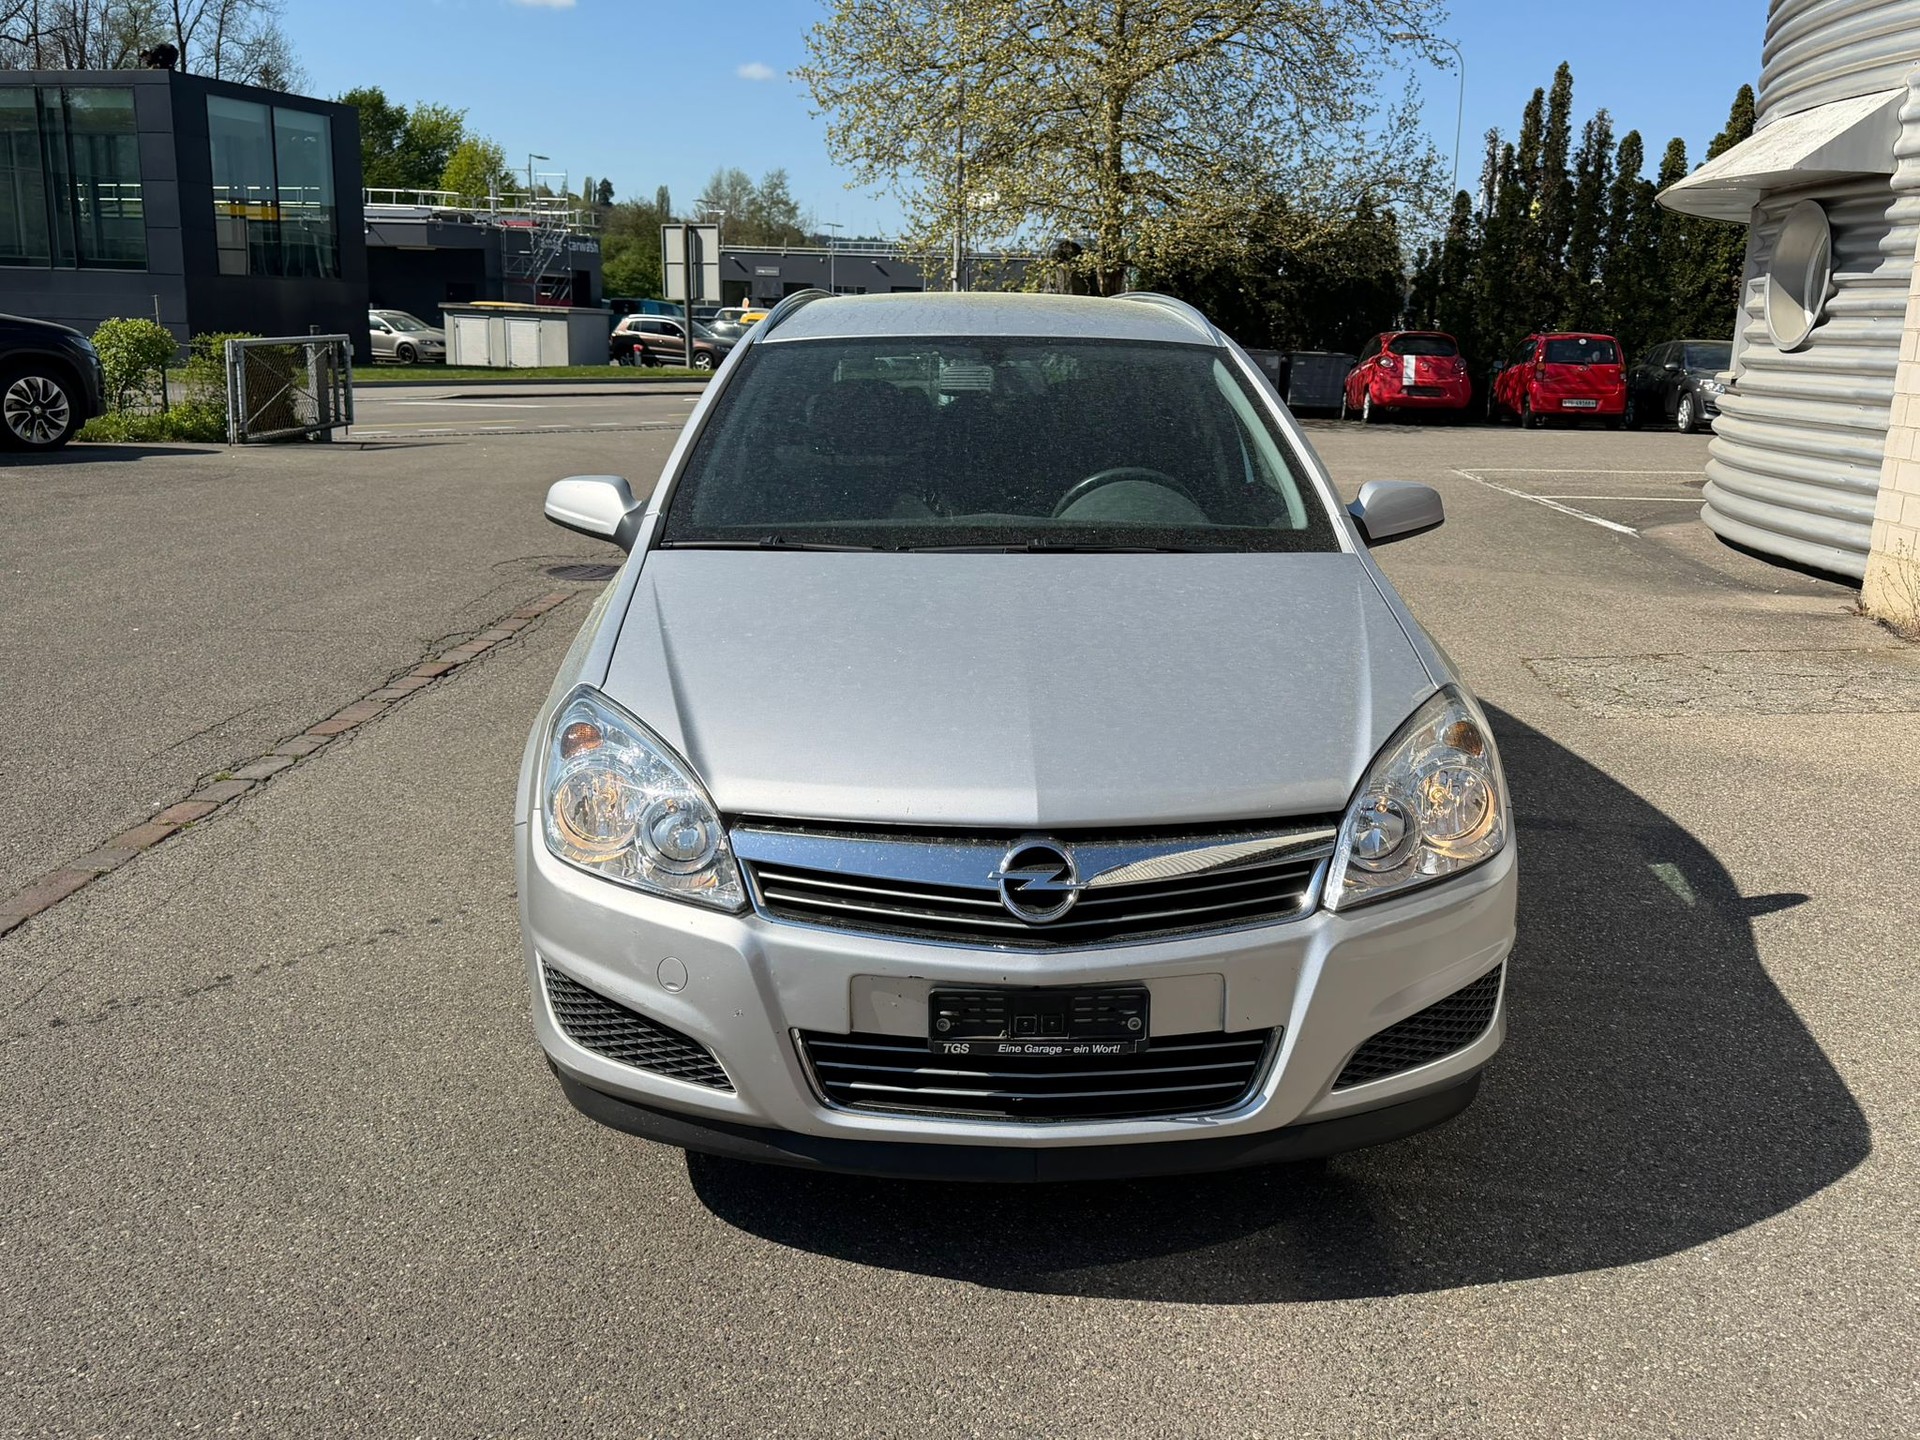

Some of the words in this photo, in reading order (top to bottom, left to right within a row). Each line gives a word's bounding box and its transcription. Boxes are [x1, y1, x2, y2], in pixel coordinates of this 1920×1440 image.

[943, 1044, 970, 1055] TGS
[998, 1044, 1020, 1053] Eine
[1025, 1044, 1063, 1055] Garage
[1074, 1044, 1090, 1053] ein
[1092, 1044, 1121, 1053] Wort!
